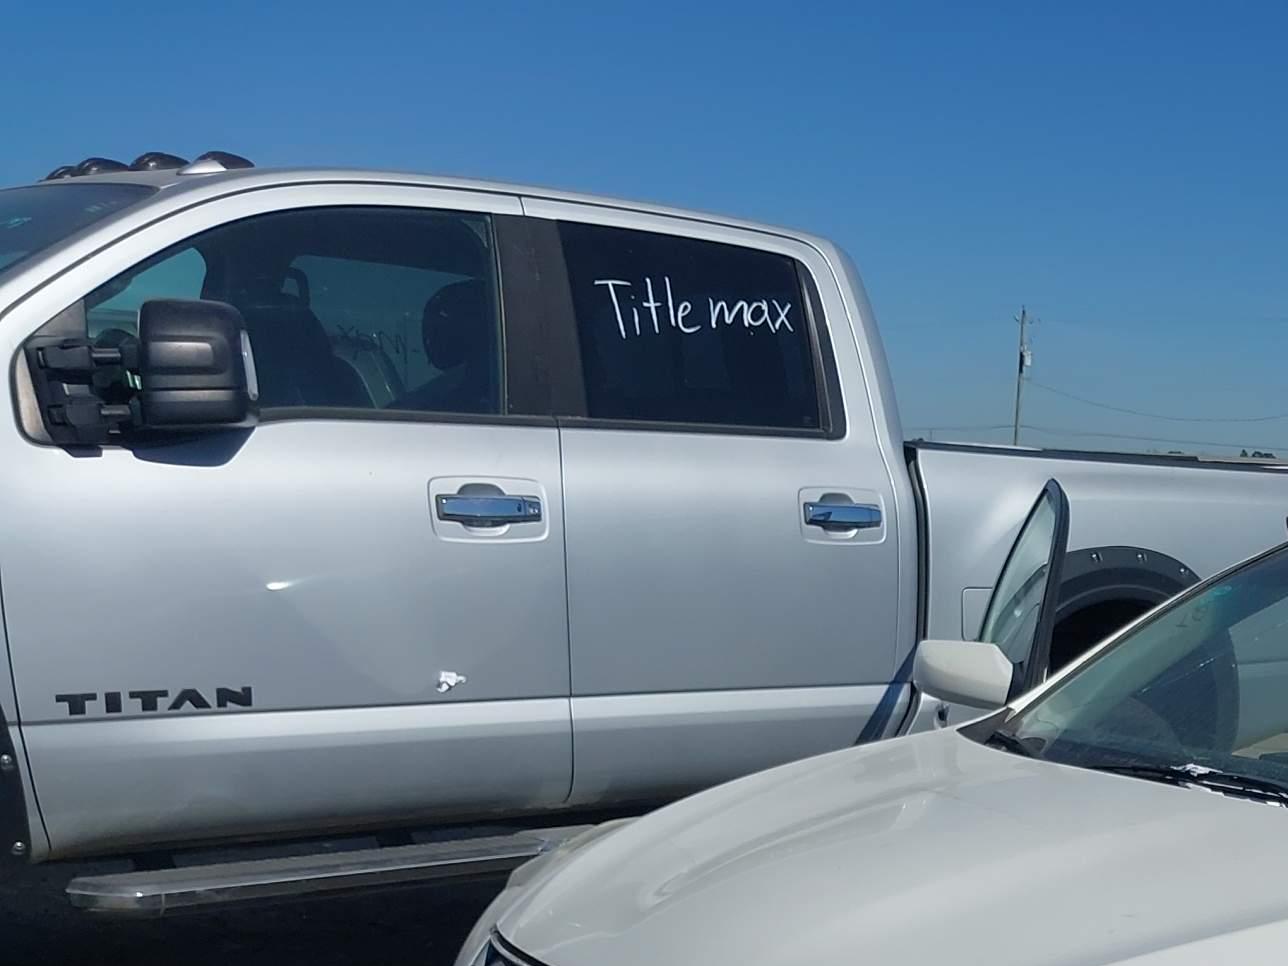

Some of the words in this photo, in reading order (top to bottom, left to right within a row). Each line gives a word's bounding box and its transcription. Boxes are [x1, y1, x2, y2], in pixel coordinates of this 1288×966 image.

[594, 276, 701, 339] Title
[708, 297, 794, 334] max
[55, 687, 253, 716] TITAN
